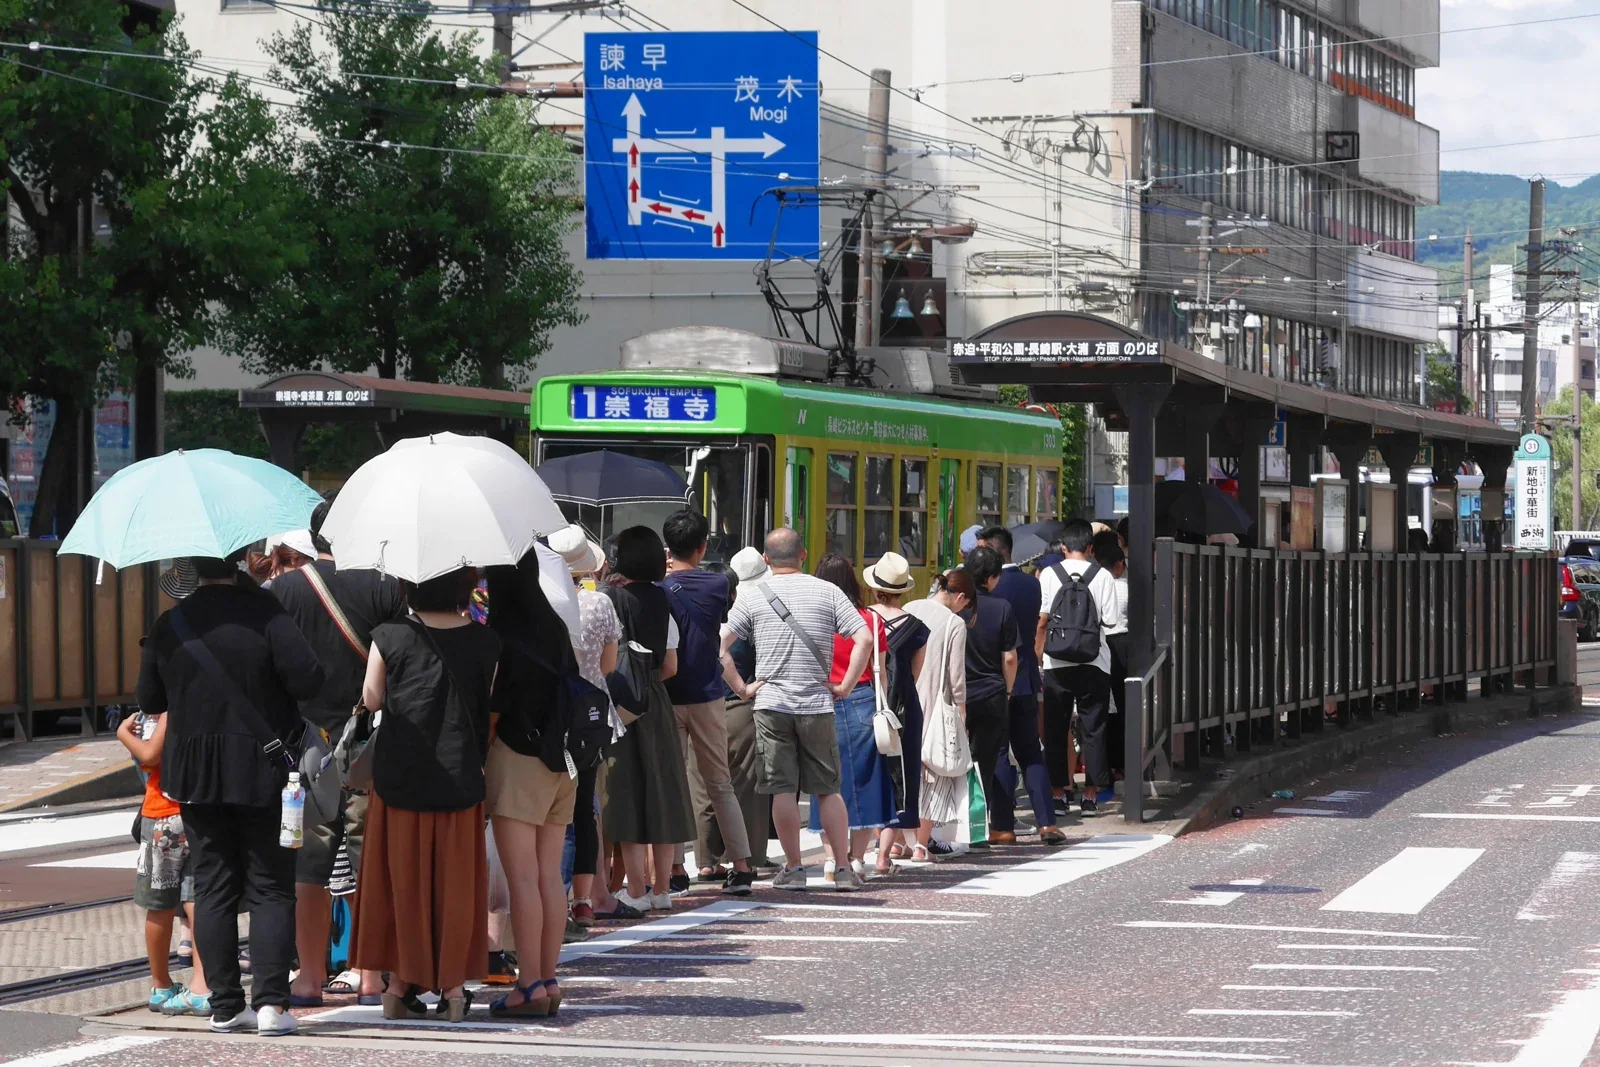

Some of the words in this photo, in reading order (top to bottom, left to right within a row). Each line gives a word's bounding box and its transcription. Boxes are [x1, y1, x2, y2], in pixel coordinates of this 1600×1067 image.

[603, 74, 663, 92] Isahaya
[734, 75, 803, 103] 茂木
[750, 106, 788, 124] Mogi
[1095, 342, 1119, 356] 方面
[1124, 342, 1159, 355] のりば
[345, 391, 369, 401] のりば
[583, 386, 596, 418] 1
[610, 387, 661, 396] SOFUKUJI
[663, 388, 703, 396] TEMPLE
[604, 396, 709, 418] 崇福寺
[1527, 442, 1537, 450] 31
[1526, 466, 1538, 518] 新地中華街
